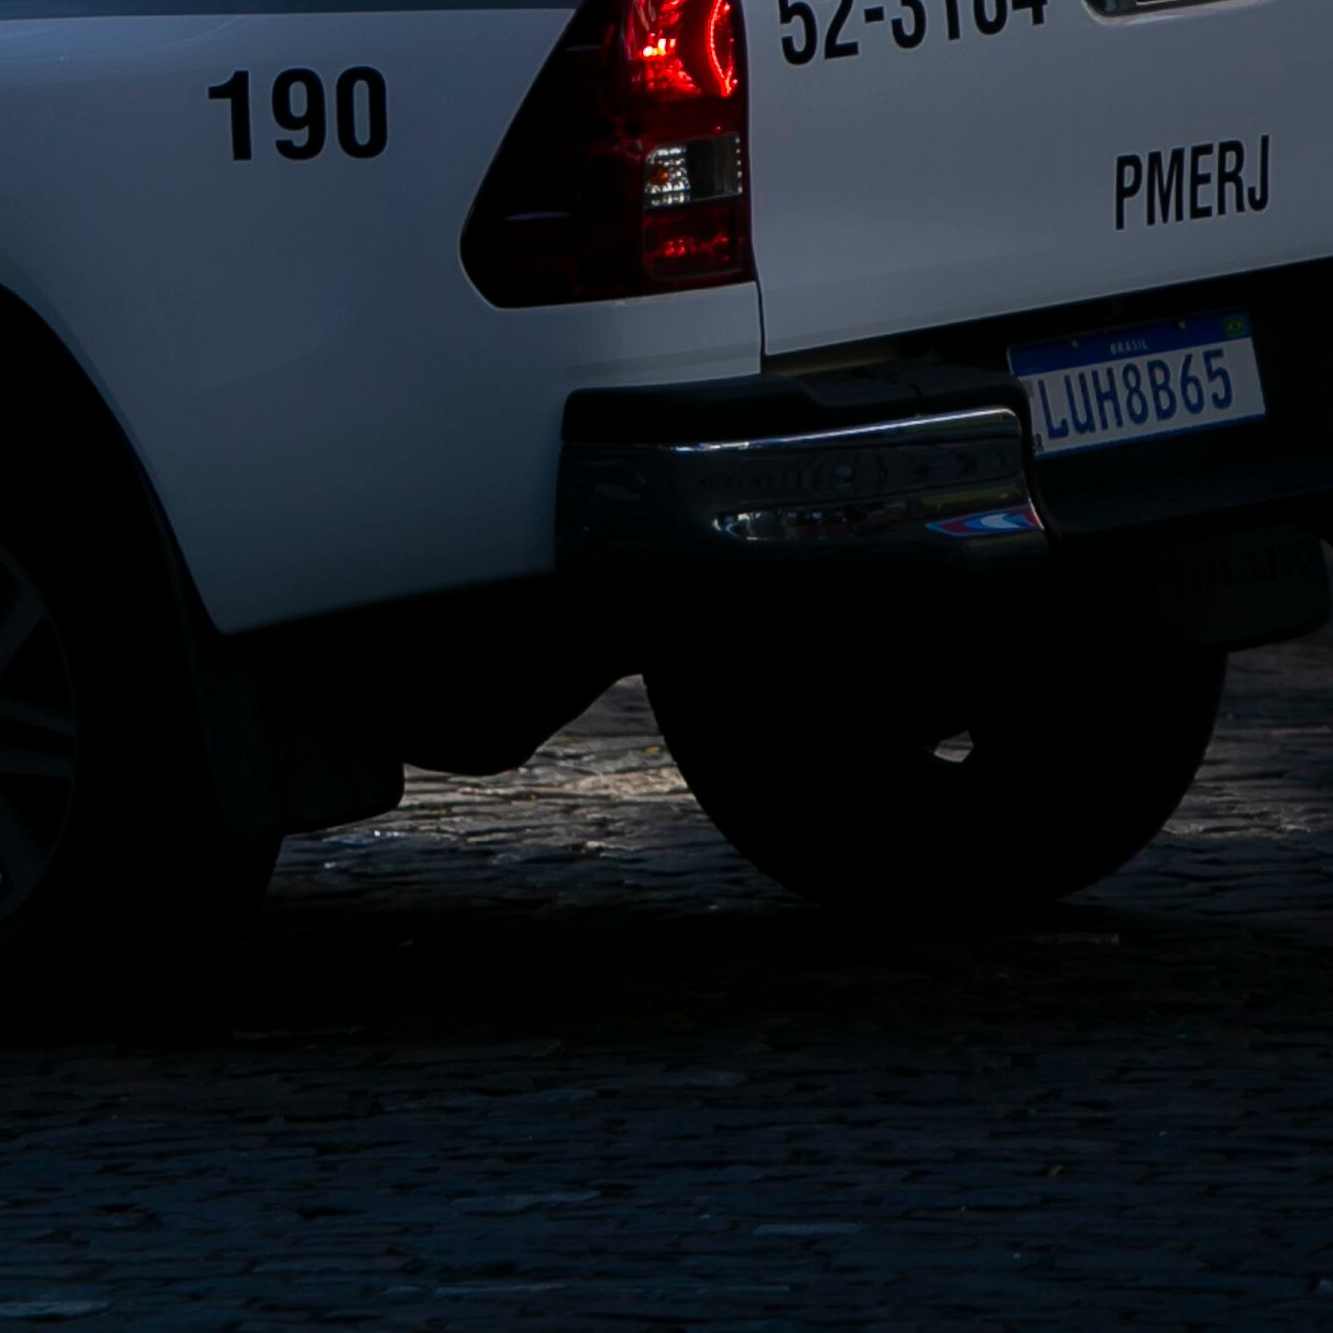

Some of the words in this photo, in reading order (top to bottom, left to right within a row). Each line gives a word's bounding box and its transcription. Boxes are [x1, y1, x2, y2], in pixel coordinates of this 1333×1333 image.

[208, 66, 387, 160] 190
[1115, 134, 1270, 230] PMERJ
[1038, 348, 1233, 438] LUH8B65
